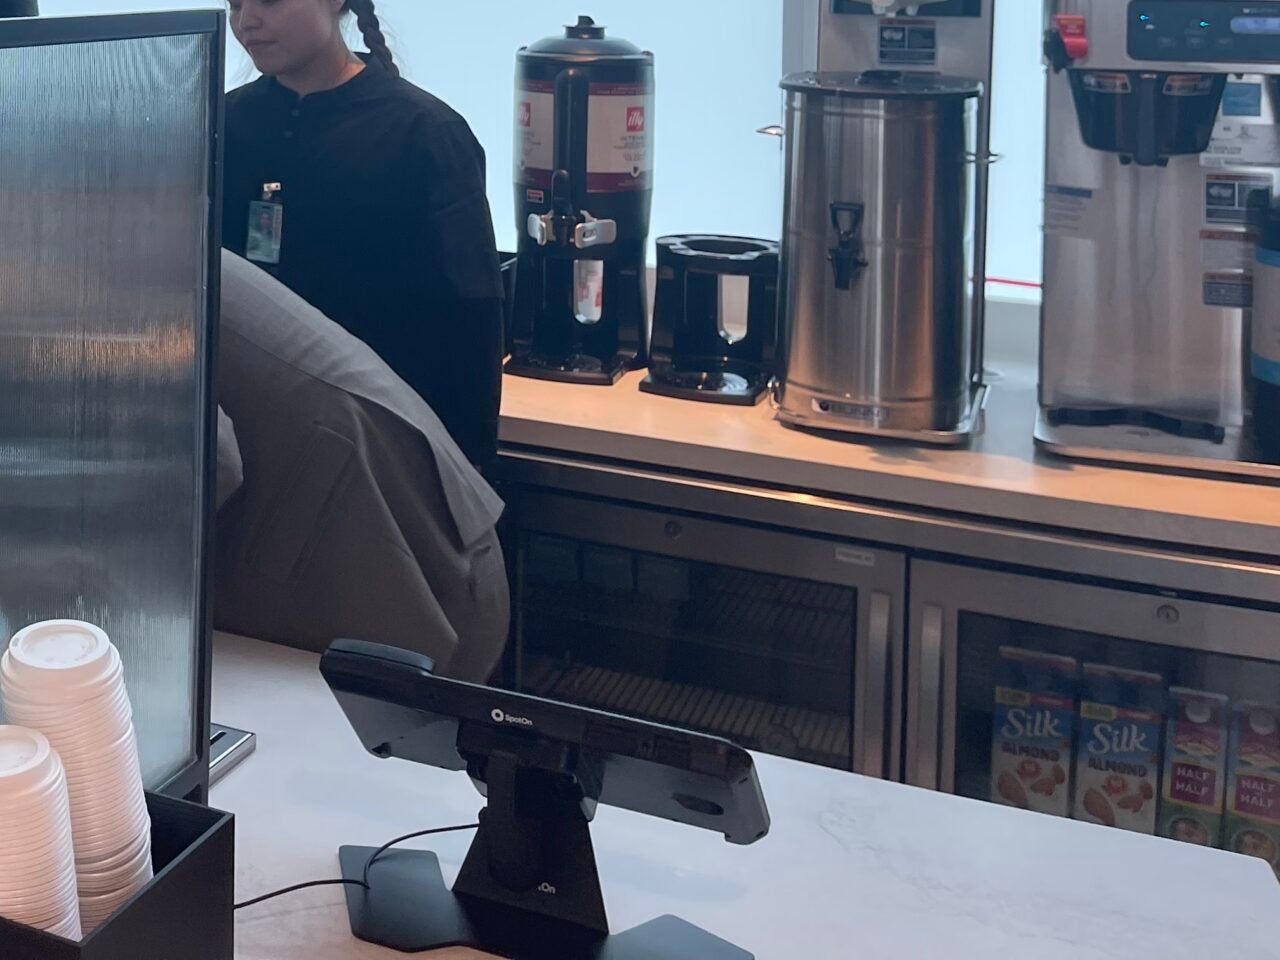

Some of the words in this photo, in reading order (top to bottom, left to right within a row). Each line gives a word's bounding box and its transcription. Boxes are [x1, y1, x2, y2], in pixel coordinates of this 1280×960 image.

[627, 110, 644, 129] illy
[1001, 709, 1062, 738] Silk
[1088, 723, 1151, 754] Silk
[1001, 741, 1060, 762] ALMOND
[1088, 757, 1148, 778] ALMOND
[1176, 766, 1211, 782] HALF
[1175, 782, 1209, 797] HALF
[1241, 779, 1277, 794] HALF
[1240, 794, 1275, 810] HALF
